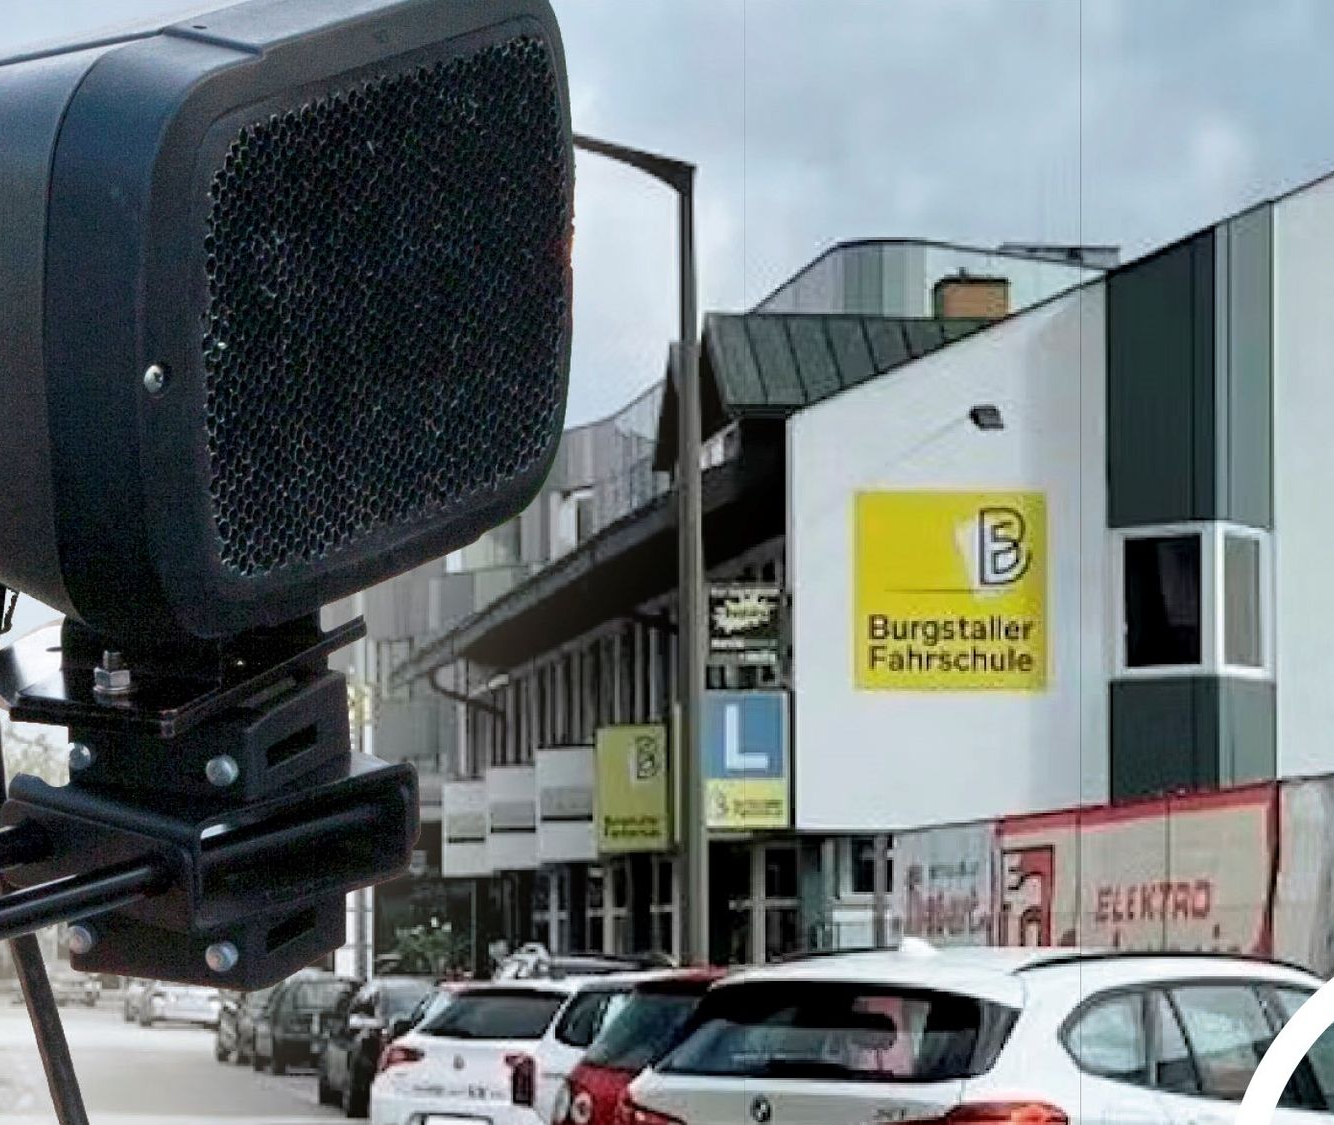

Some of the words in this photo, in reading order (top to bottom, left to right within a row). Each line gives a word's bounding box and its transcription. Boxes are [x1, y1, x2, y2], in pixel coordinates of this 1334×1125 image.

[868, 614, 1034, 646] Burgstaller
[868, 645, 1034, 673] Fahrschule
[725, 703, 769, 769] L
